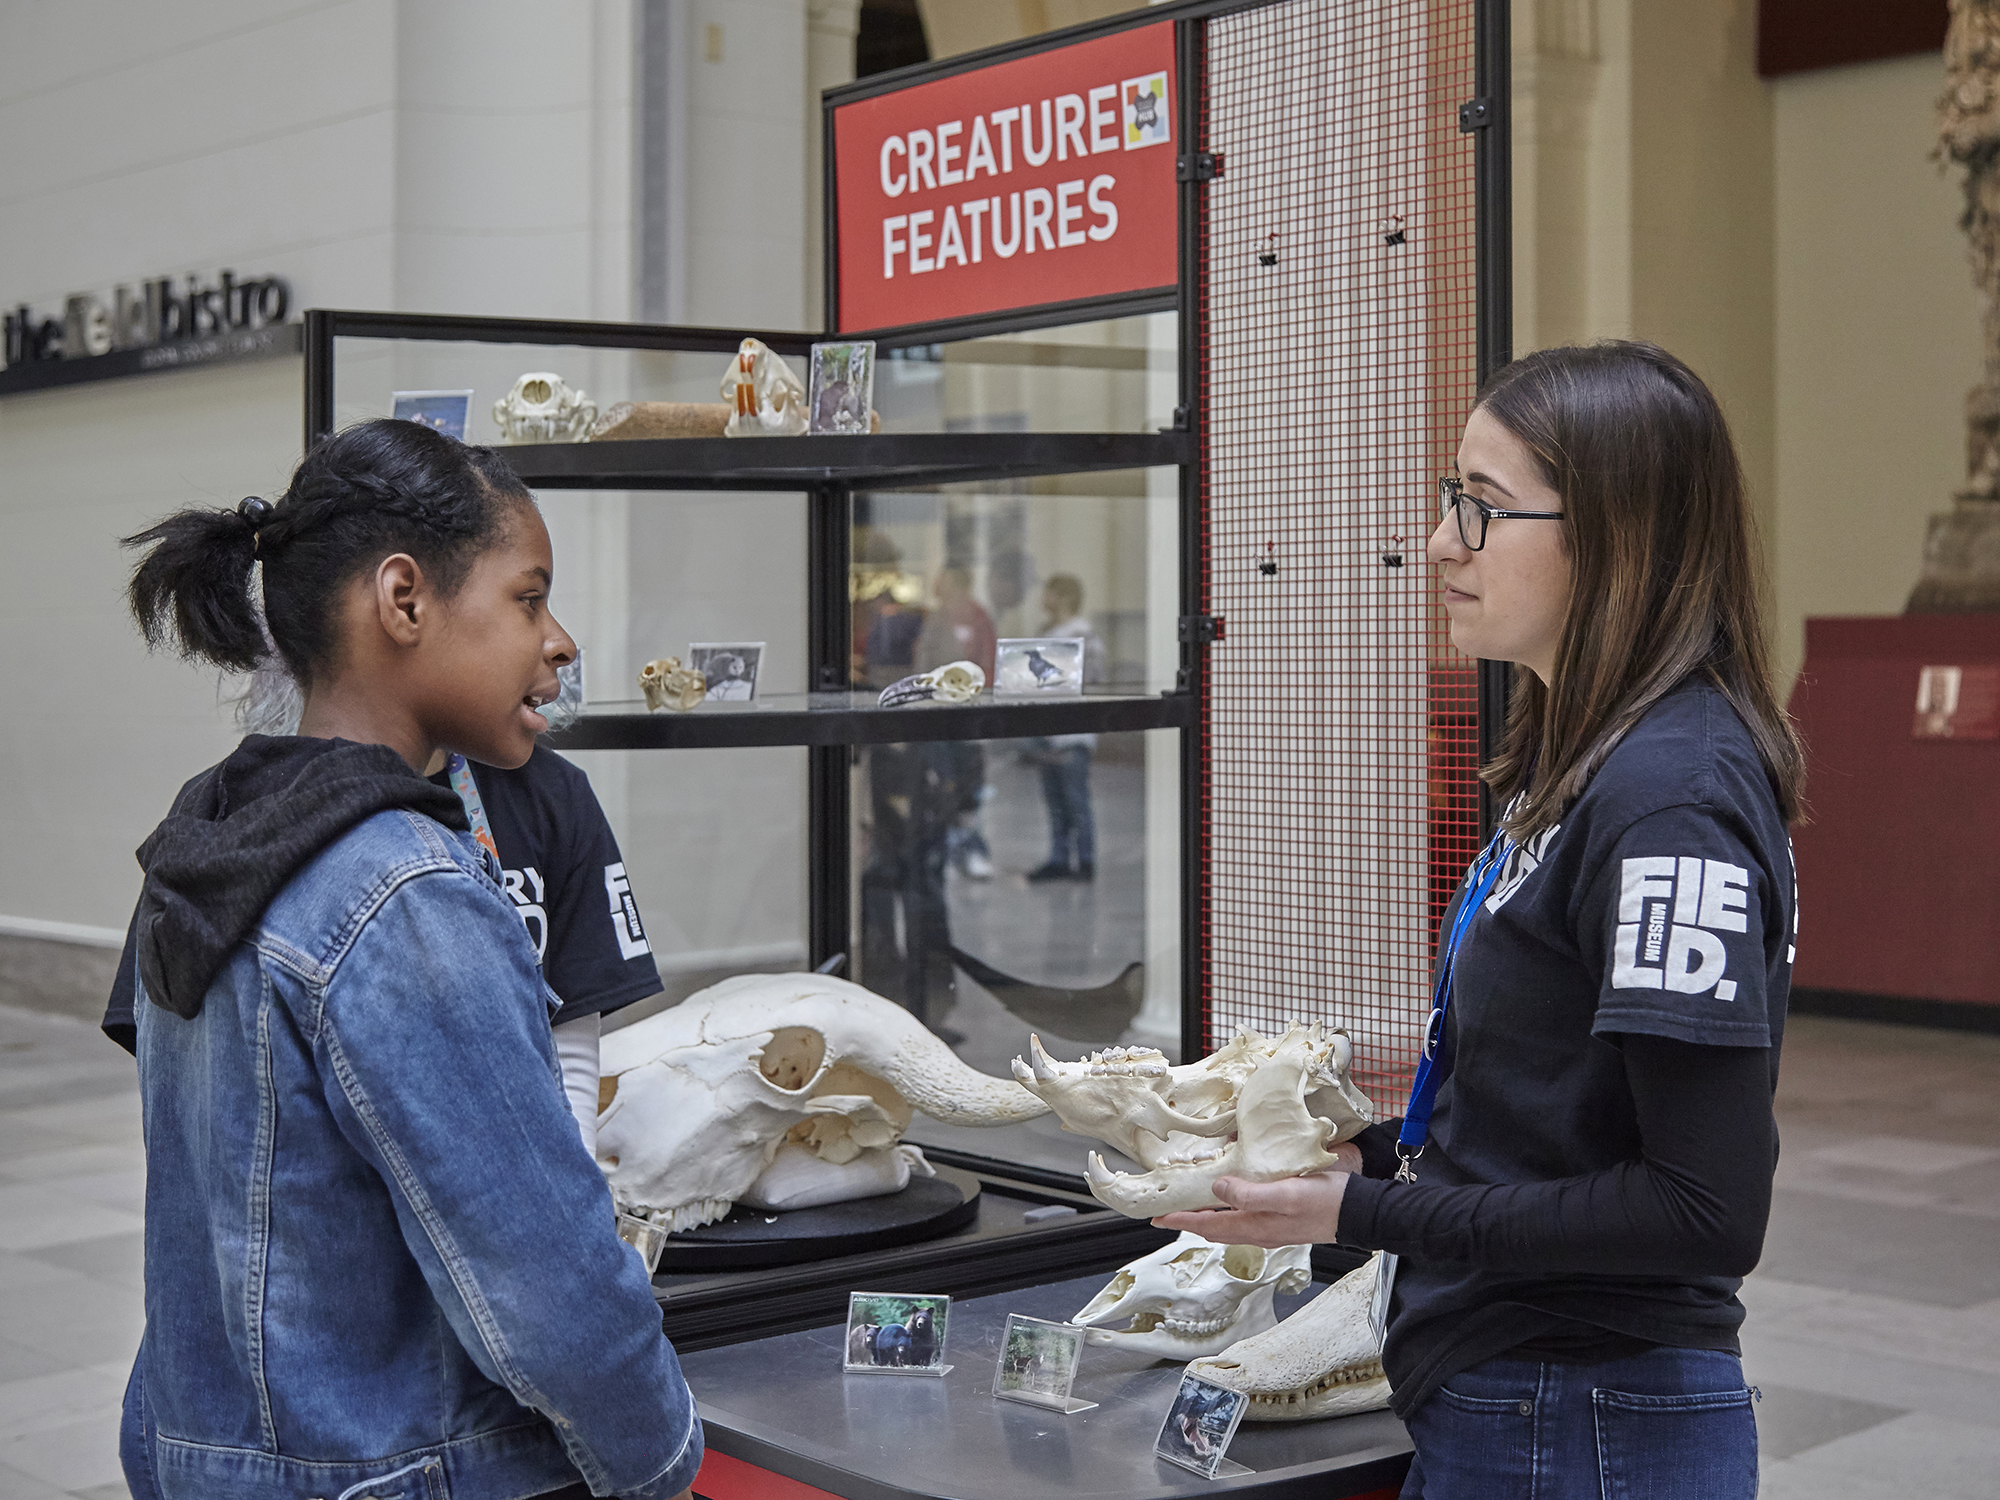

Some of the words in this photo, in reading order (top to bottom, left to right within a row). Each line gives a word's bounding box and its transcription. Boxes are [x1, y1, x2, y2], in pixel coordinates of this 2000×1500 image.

[880, 84, 1120, 198] CREATURE
[883, 174, 1118, 279] FEATURES
[159, 271, 289, 340] bistro
[622, 894, 642, 937] MUSEUM
[1644, 903, 1667, 962] MUSEUM
